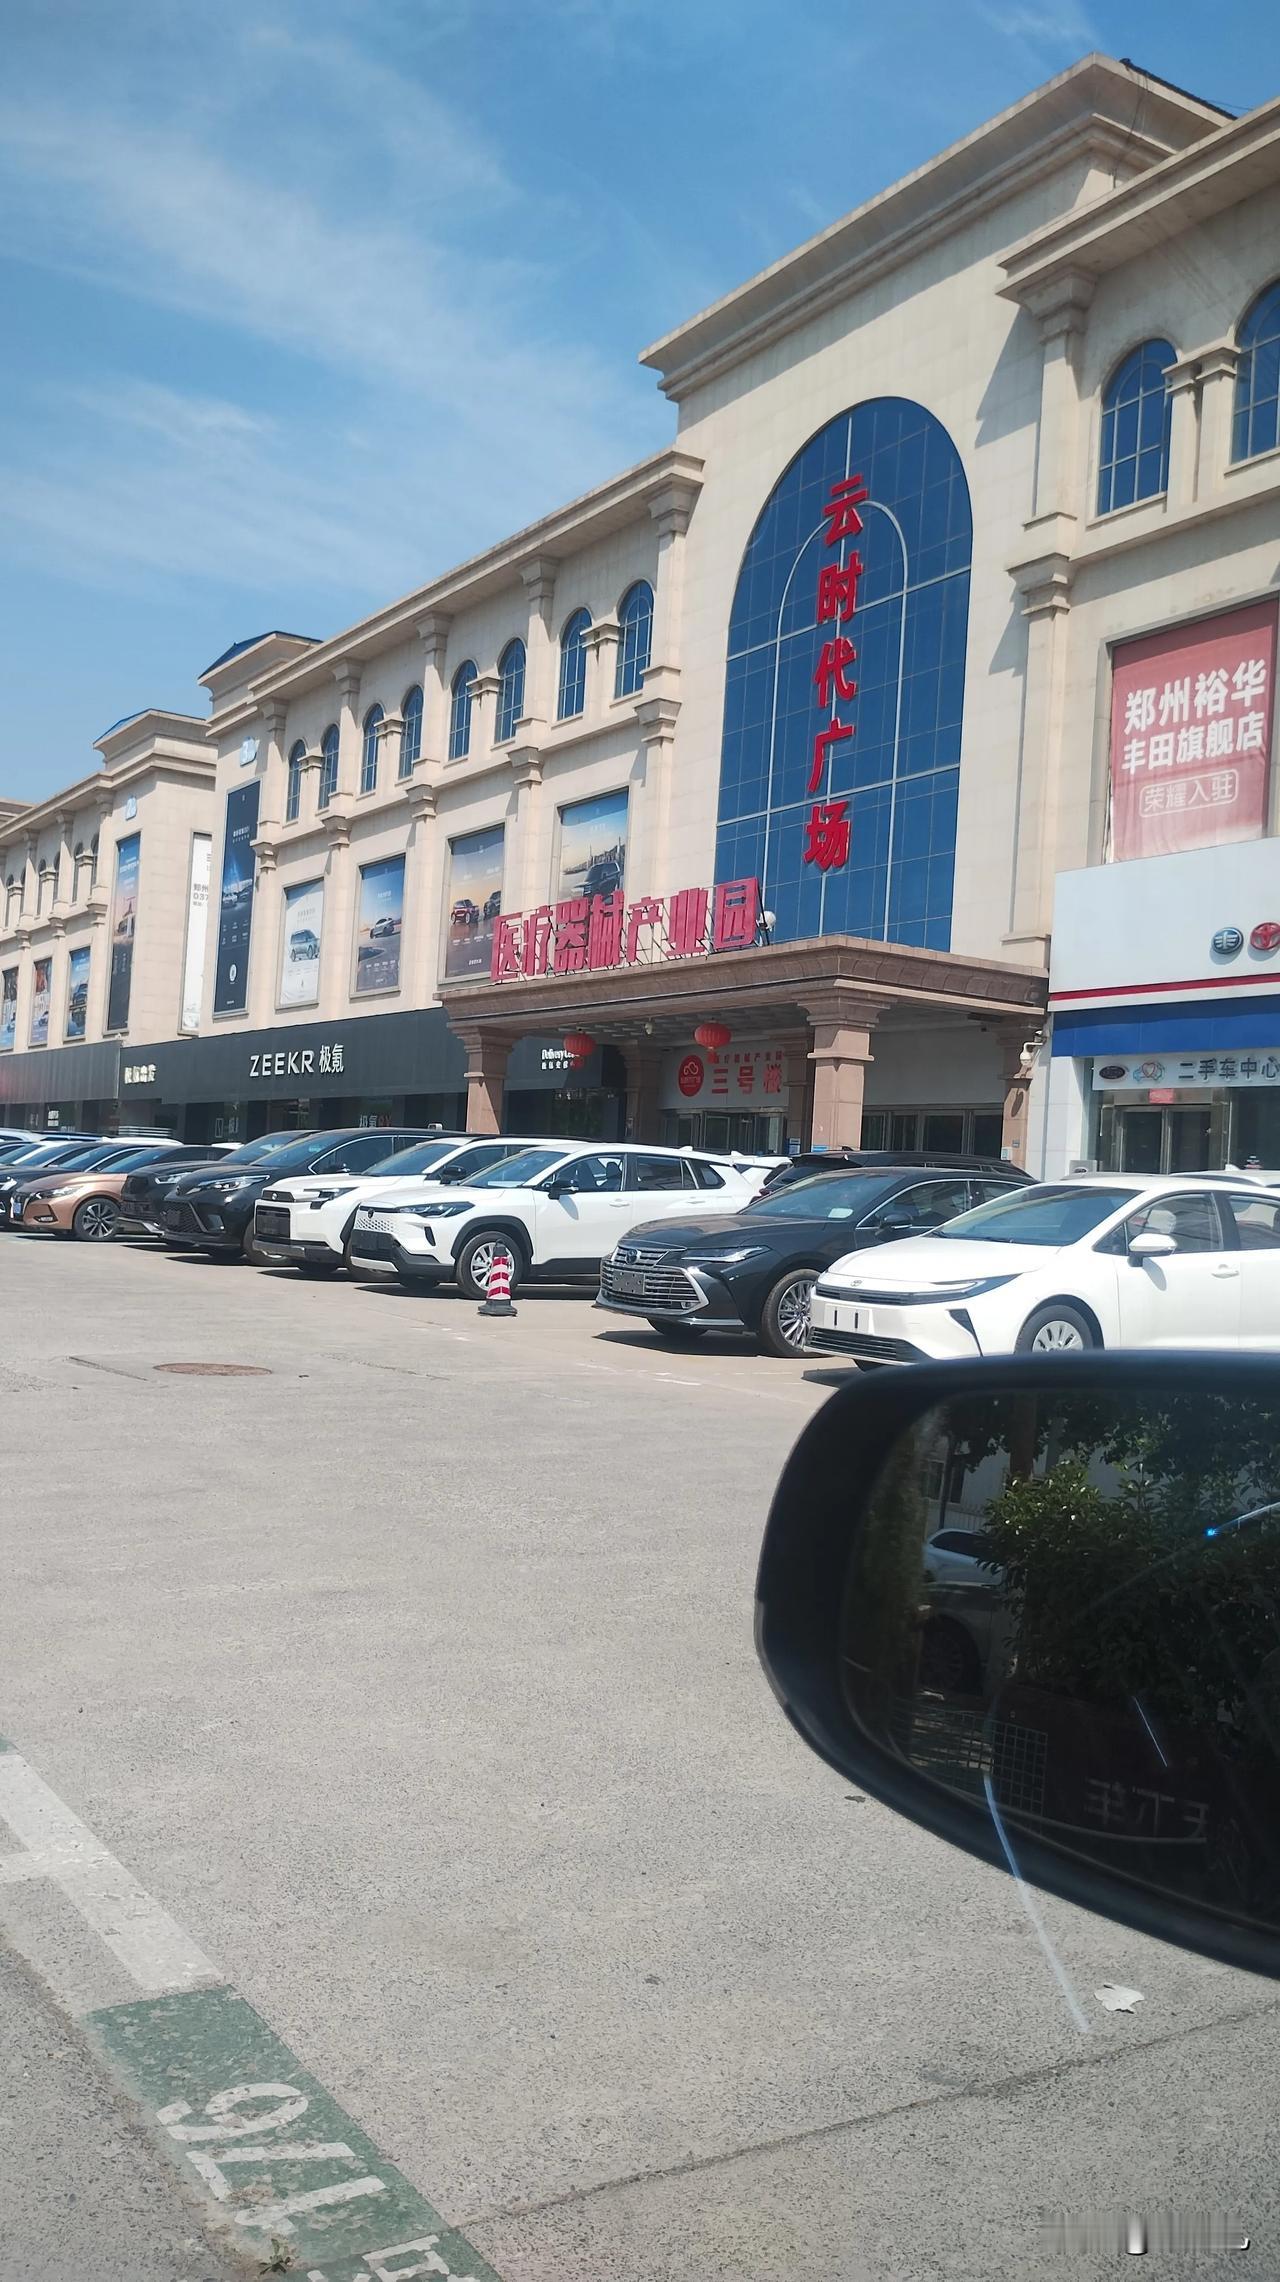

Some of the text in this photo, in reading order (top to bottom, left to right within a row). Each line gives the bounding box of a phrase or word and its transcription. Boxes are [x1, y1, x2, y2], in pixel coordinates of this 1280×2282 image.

[803, 474, 870, 871] 云时代广场
[1124, 659, 1267, 735] 郑州裕华
[1121, 711, 1265, 775] 丰田旗舰店
[1143, 774, 1234, 812] 荣耀入驻
[490, 876, 759, 983] 医疗器械产业园
[250, 1043, 345, 1077] ZEEKR 极氪
[711, 1064, 784, 1094] 三号楼
[1178, 1056, 1280, 1082] 二手车中心
